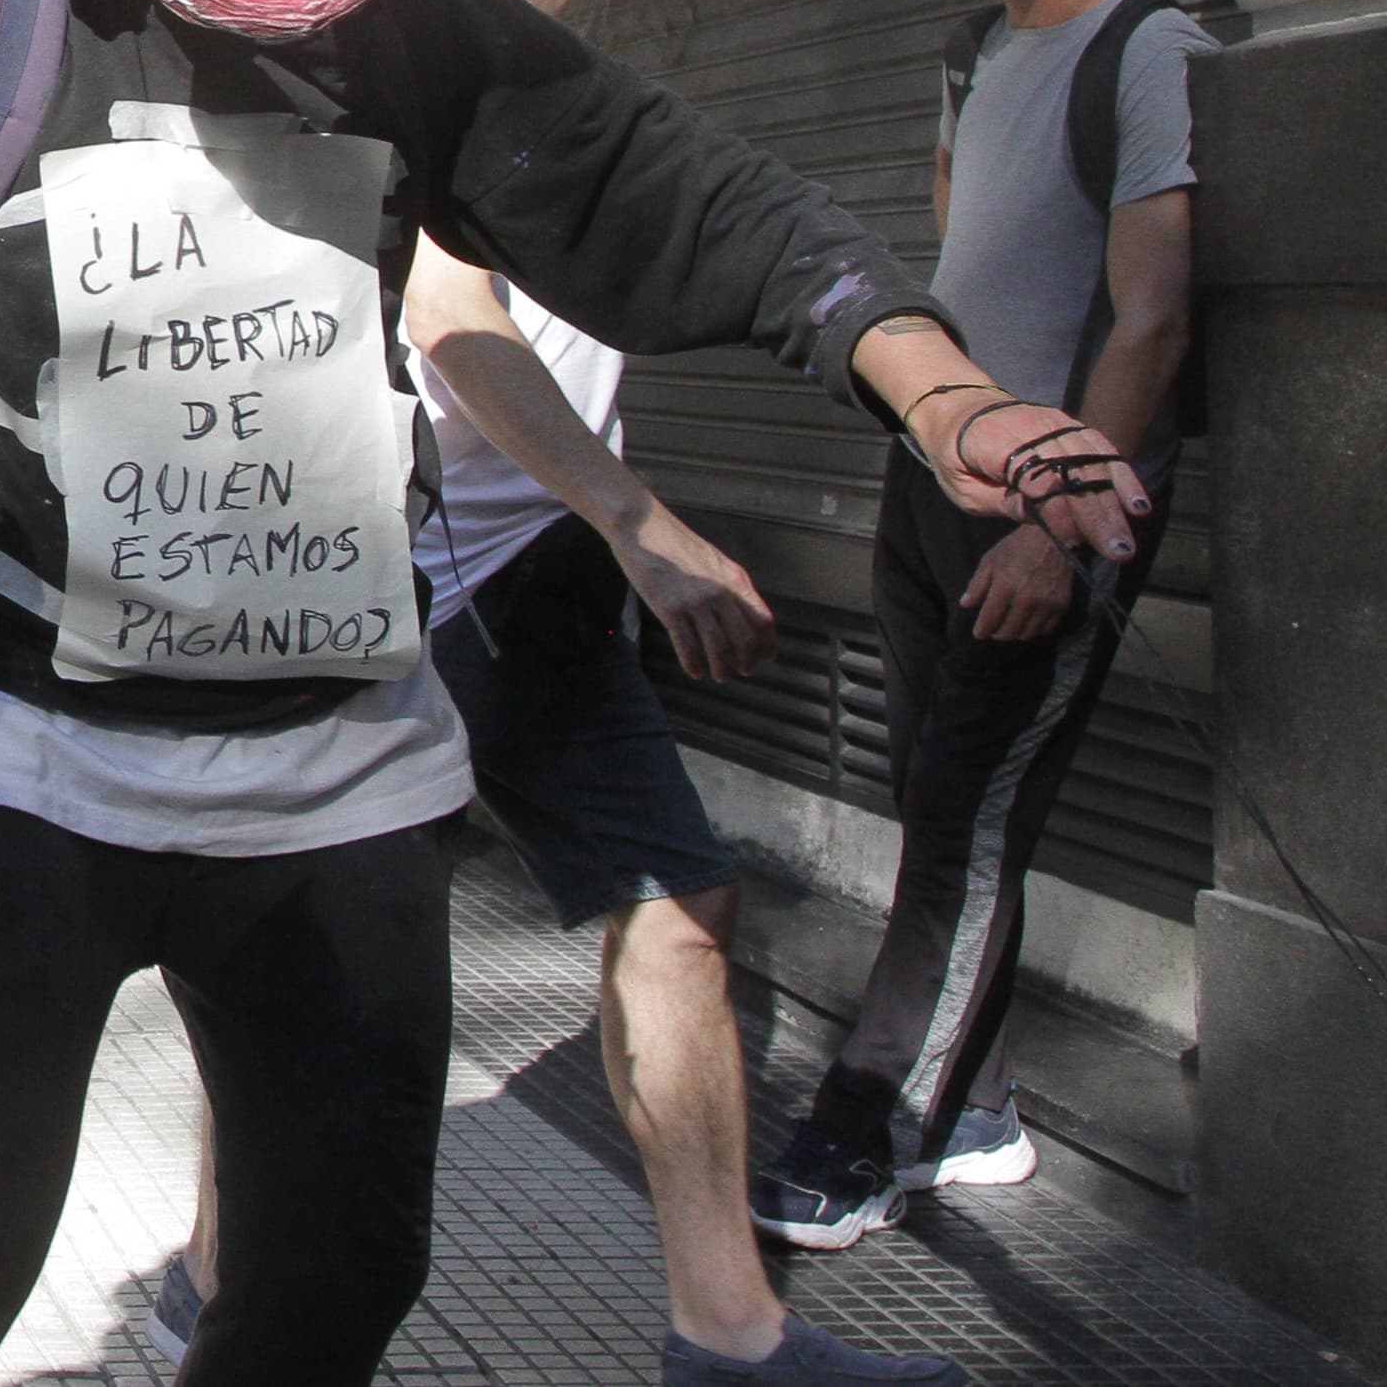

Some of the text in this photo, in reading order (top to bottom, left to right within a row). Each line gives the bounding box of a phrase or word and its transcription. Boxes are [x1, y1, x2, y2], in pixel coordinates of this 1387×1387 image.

[78, 211, 207, 296] ¿LA
[98, 298, 340, 383] LIBERTAD
[179, 390, 264, 442] DE
[102, 459, 294, 519] QUIEN
[109, 523, 361, 583] ESTAMOS
[114, 597, 393, 666] PAGANDO?
